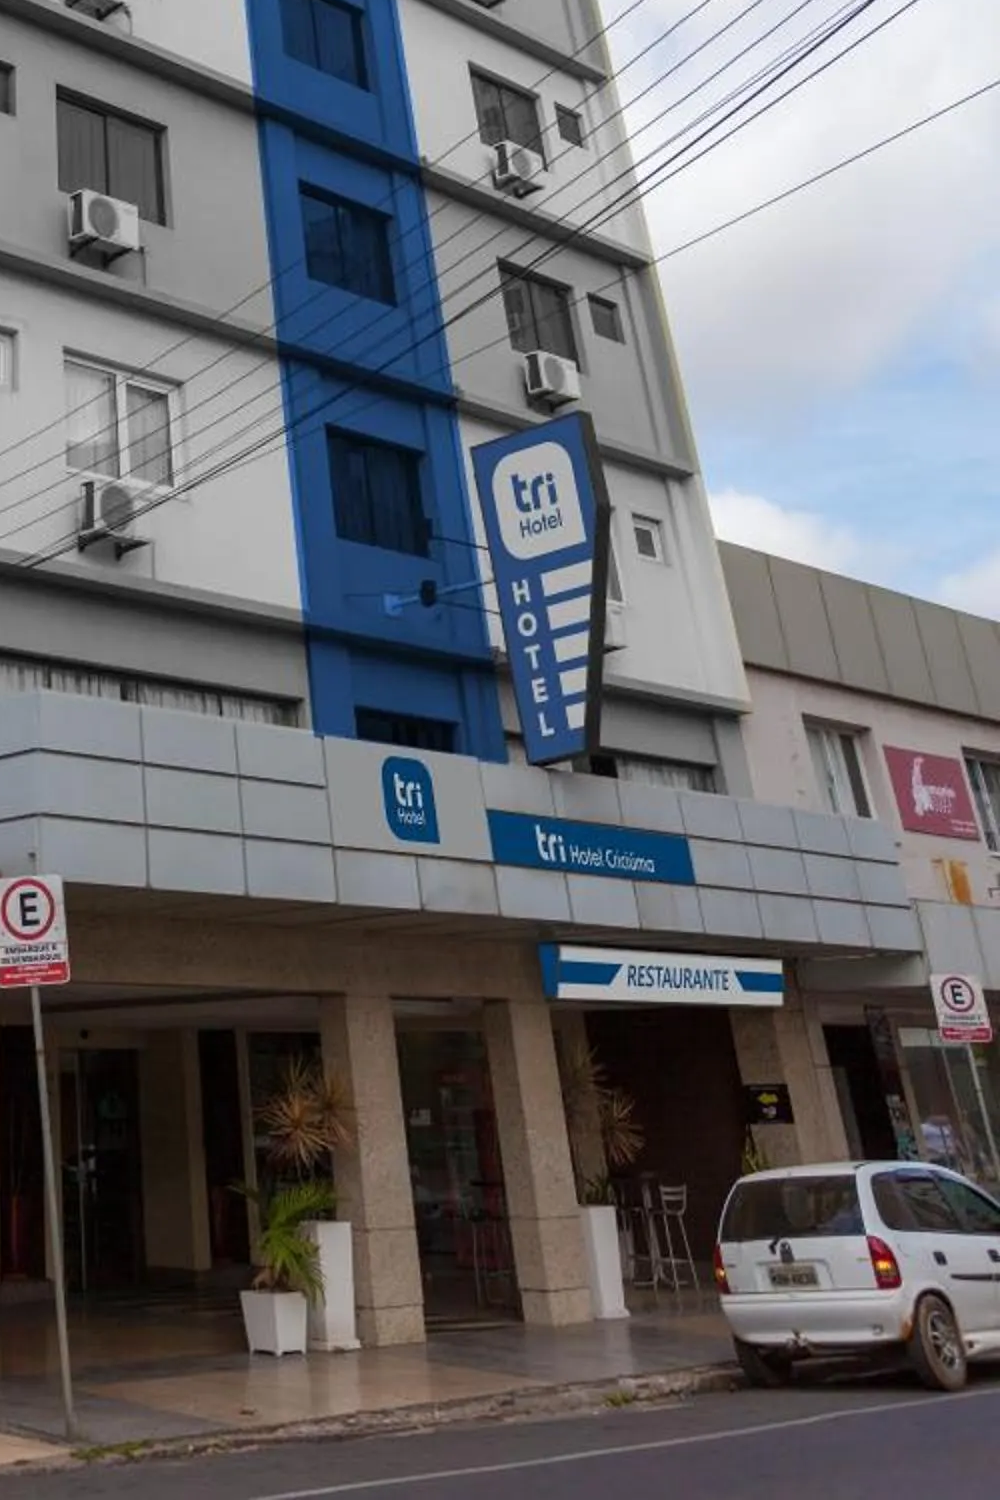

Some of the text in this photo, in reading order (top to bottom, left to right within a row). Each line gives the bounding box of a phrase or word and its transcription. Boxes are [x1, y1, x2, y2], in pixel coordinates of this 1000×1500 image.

[510, 472, 558, 513] tri
[519, 507, 563, 539] Hotel
[511, 578, 556, 737] HOTEL
[393, 771, 423, 809] tri
[397, 807, 427, 826] Hotel
[535, 824, 656, 873] tri Hotel Criciúma
[19, 891, 41, 927] E
[627, 965, 729, 991] RESTAURANTE
[950, 984, 966, 1005] E
